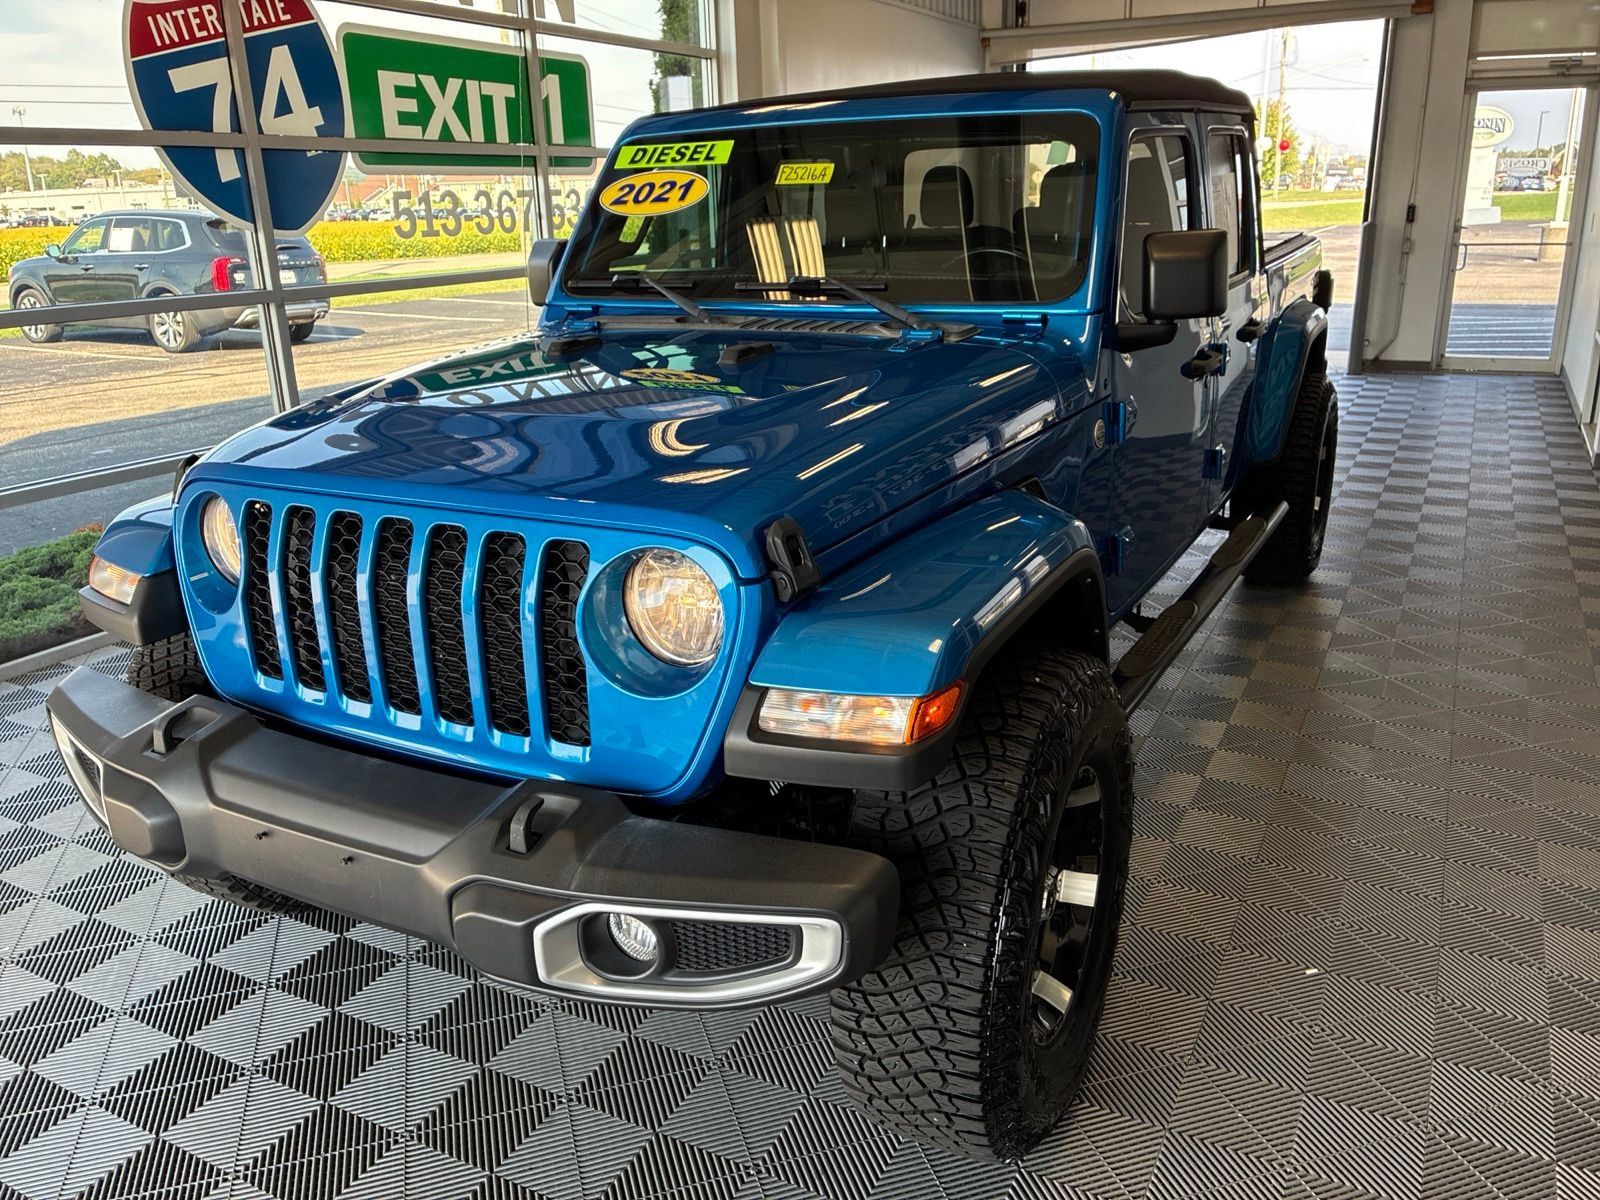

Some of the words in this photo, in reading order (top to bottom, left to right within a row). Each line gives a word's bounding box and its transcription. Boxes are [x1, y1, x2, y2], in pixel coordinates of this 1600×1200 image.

[147, 0, 291, 47] INTERTATE
[167, 45, 325, 183] 74
[377, 69, 516, 144] EXIT
[540, 73, 565, 145] 1
[1474, 117, 1506, 133] ONIN
[628, 143, 718, 165] DIESEL
[778, 164, 829, 183] F25216A
[609, 178, 697, 206] 2021
